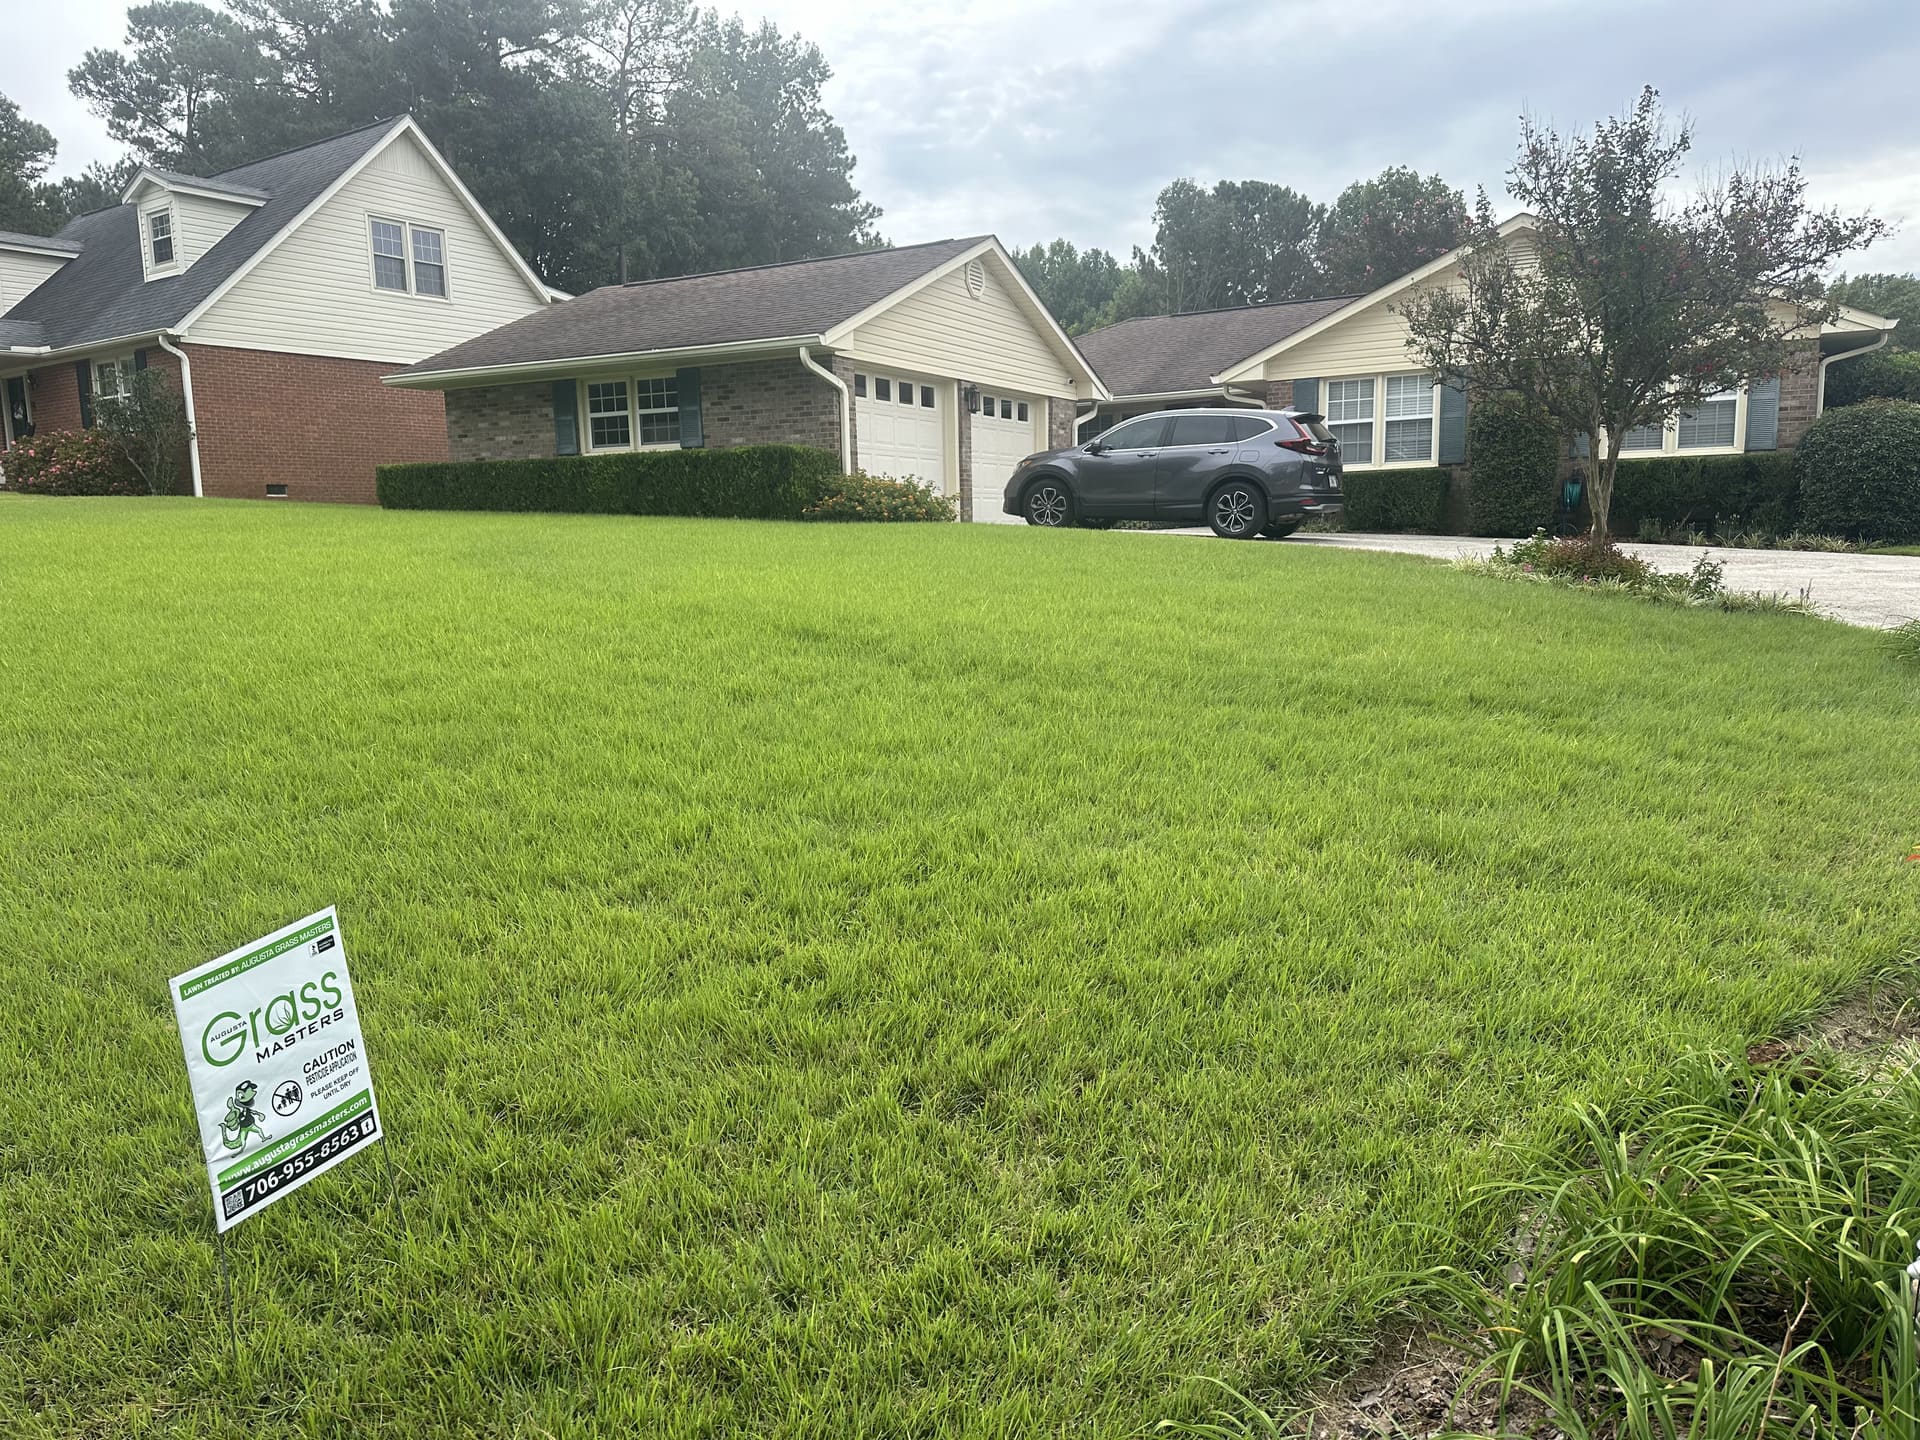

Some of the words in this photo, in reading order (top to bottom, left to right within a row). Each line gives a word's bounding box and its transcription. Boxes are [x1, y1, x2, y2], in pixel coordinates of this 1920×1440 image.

[184, 983, 203, 996] LAWN
[204, 971, 230, 987] TREATED
[241, 949, 274, 970] AUGUSTA
[275, 937, 299, 953] GRASS
[300, 921, 331, 941] MASTERS
[201, 971, 342, 1067] Grass
[210, 1020, 248, 1043] AUGUSTA
[256, 1008, 344, 1063] MASTERS
[303, 1038, 355, 1074] CAUTION
[306, 1066, 330, 1086] PESTICIDE
[329, 1051, 358, 1073] APPLICATION
[311, 1083, 333, 1098] PLEASE
[333, 1073, 348, 1086] KEEP
[348, 1067, 360, 1077] OFF
[323, 1089, 340, 1099] UNTIL
[340, 1080, 352, 1090] DRY
[245, 1125, 360, 1202] 706-955-8563
